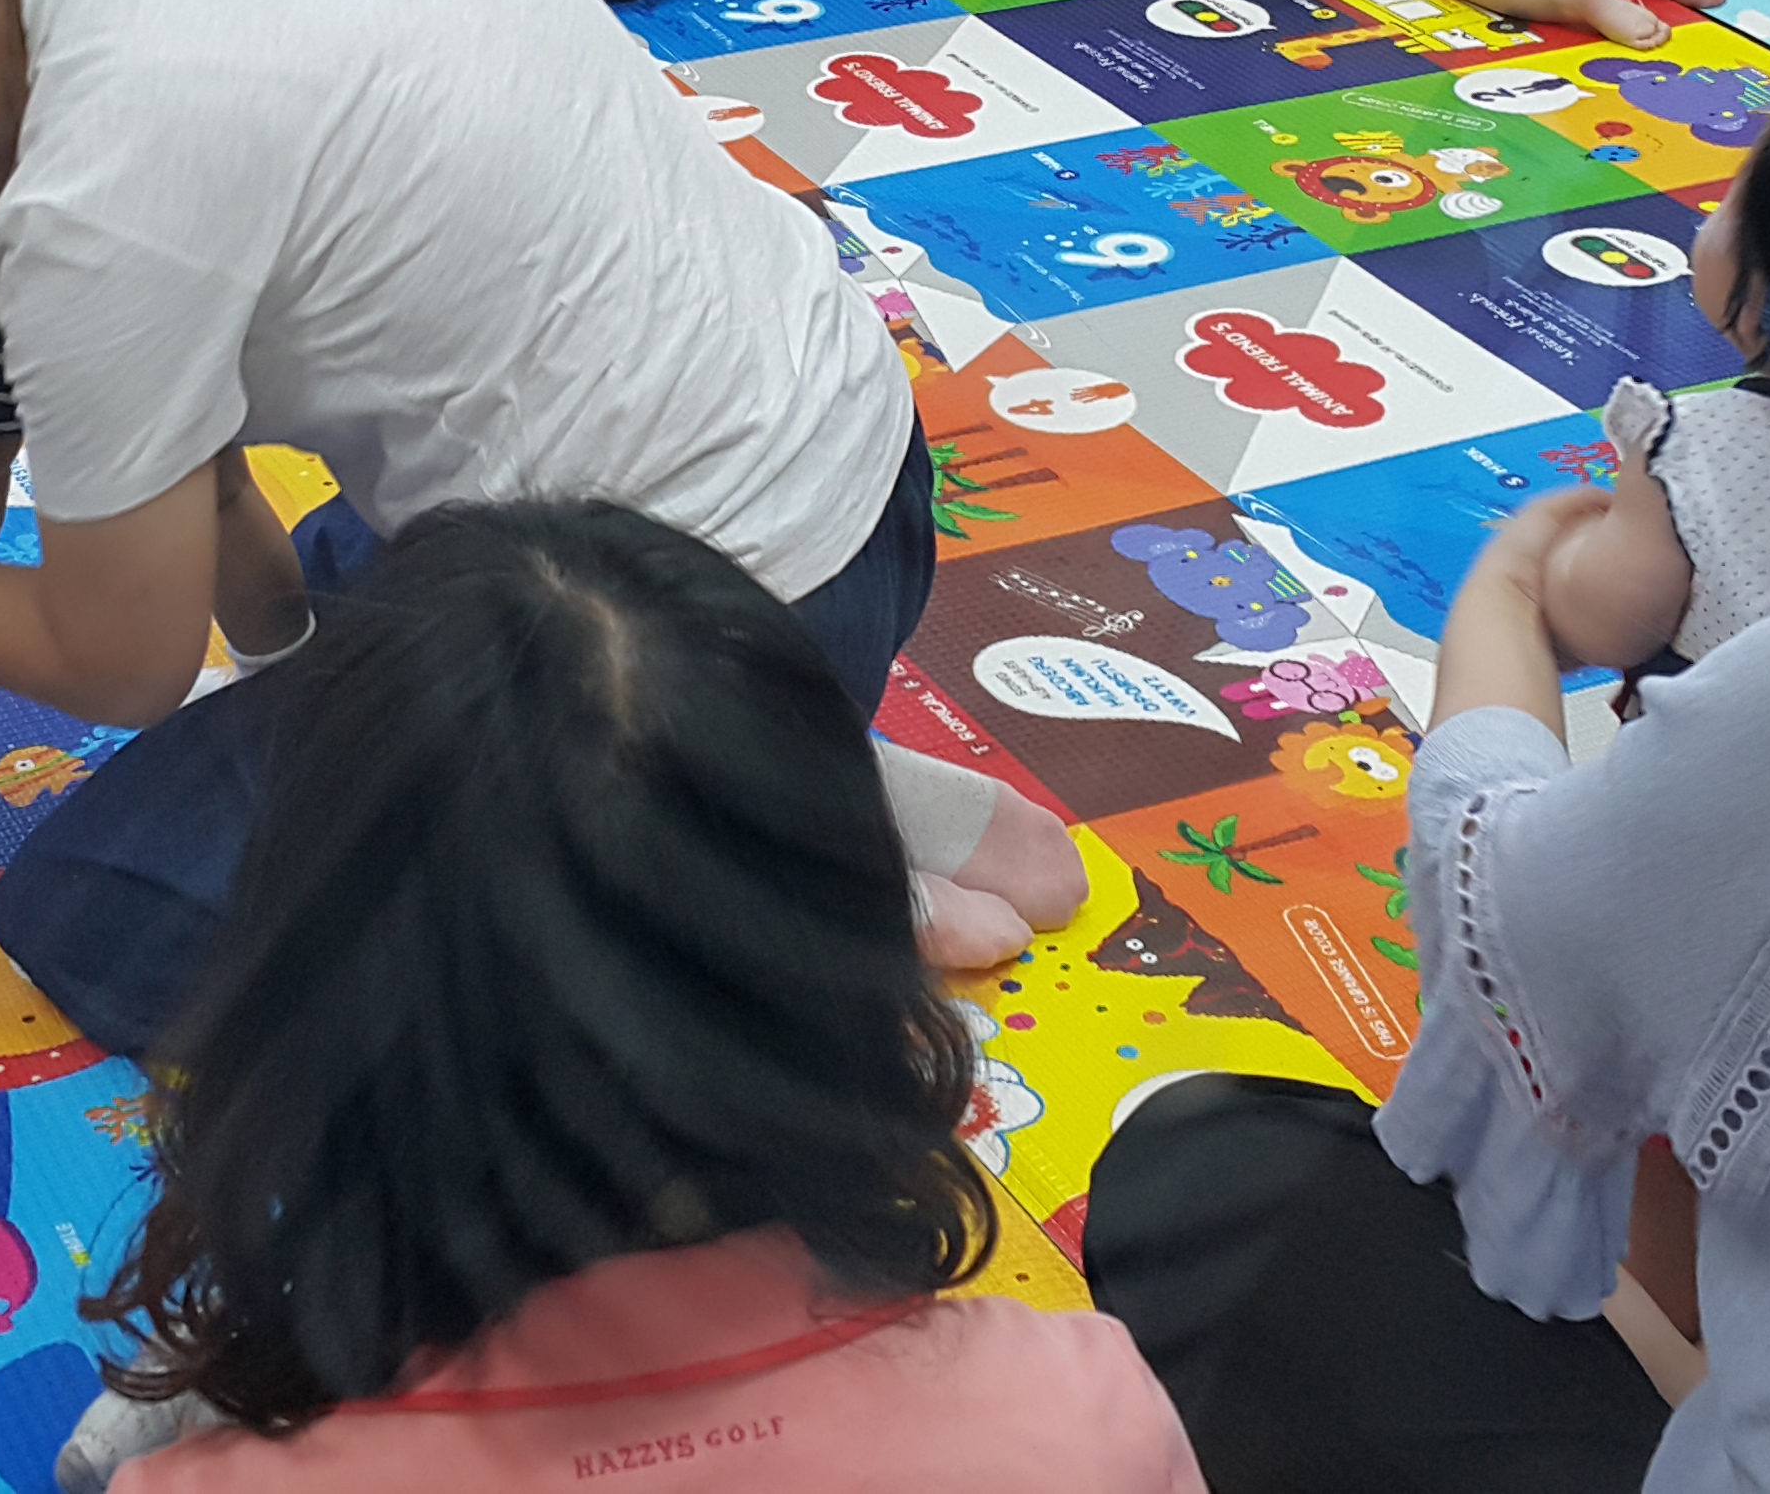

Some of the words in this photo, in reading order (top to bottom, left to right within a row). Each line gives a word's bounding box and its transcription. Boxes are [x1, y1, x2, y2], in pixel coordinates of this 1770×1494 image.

[894, 96, 950, 131] ANIMAL
[1210, 321, 1290, 373] FRIEND'S
[1282, 370, 1355, 416] ANIMAL
[1028, 657, 1092, 706] ABCDEFG
[1060, 658, 1125, 708] HIJKLMN
[1091, 658, 1161, 713] OPQRSTU
[1142, 674, 1198, 719] VWXYZ
[1303, 918, 1338, 956] COLOR
[1328, 958, 1370, 1005] ORANGE
[1360, 1006, 1379, 1020] IS
[1369, 1019, 1397, 1048] THIS
[573, 1432, 696, 1480] HAZZYS
[705, 1415, 785, 1448] GOLF
